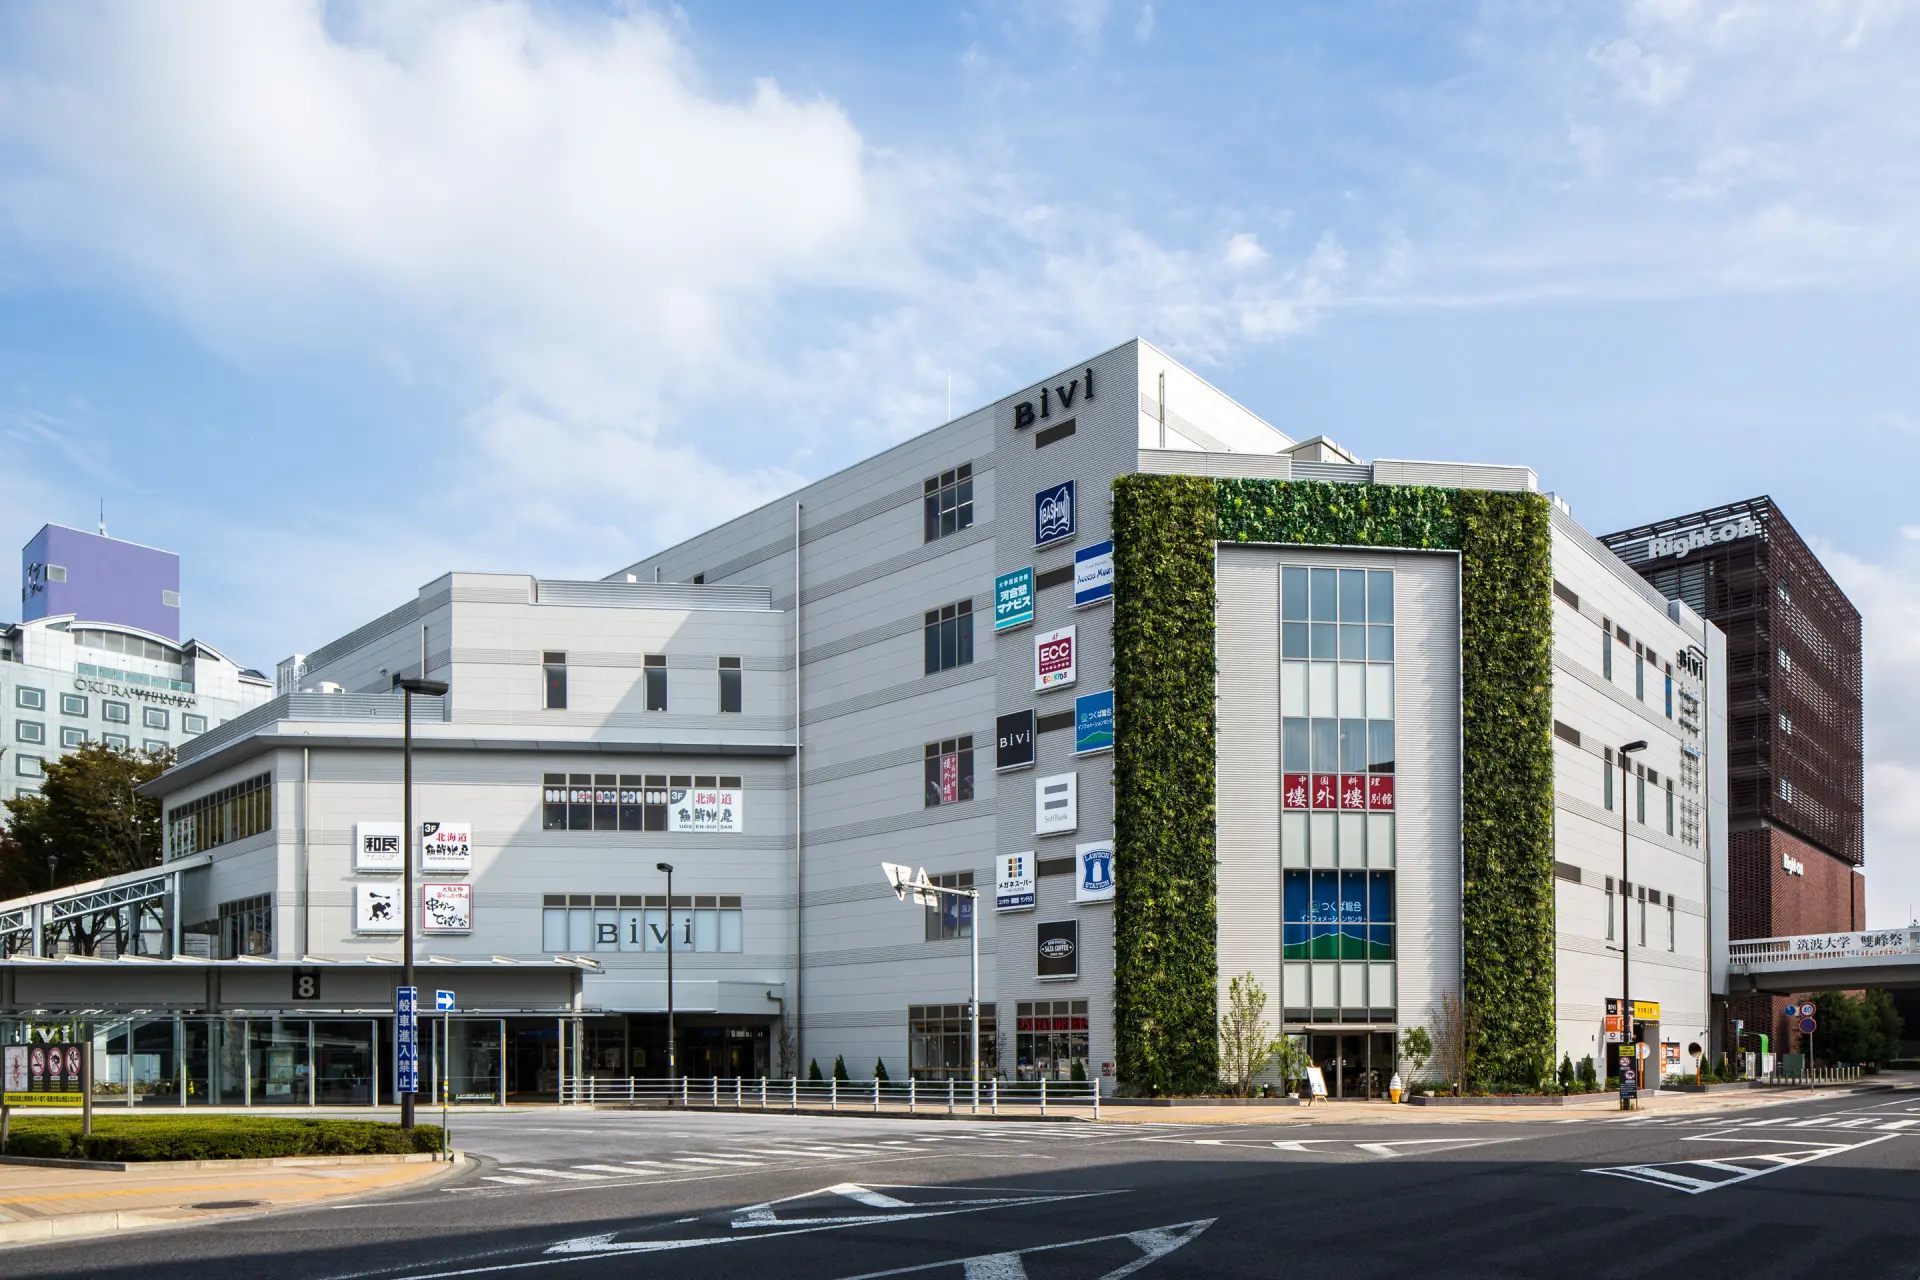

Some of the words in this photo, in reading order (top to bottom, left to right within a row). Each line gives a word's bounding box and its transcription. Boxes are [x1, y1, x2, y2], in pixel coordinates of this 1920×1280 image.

[1014, 368, 1095, 430] BiVi
[1648, 519, 1756, 559] Right-on
[1000, 584, 1028, 602] 河合塾
[997, 595, 1031, 614] マナビス
[1041, 642, 1069, 662] ECC
[73, 678, 132, 698] OKURA
[999, 729, 1031, 748] BiVi
[671, 791, 683, 800] 3F
[695, 793, 733, 805] 北海道
[1044, 813, 1068, 823] SoftBank
[425, 824, 436, 832] 3F
[366, 837, 397, 851] 和民
[436, 833, 467, 842] 北海道
[1085, 851, 1110, 862] LAWSON
[998, 879, 1033, 890] メガネスーパー
[1085, 879, 1110, 888] STATION
[425, 897, 455, 912] 串かつ
[433, 912, 467, 927] でんがな
[596, 917, 693, 944] BiVi
[1797, 936, 1850, 951] 筑波大学
[298, 976, 315, 997] 8
[1803, 1006, 1813, 1014] 40
[399, 990, 410, 1088] 一般車進入禁止
